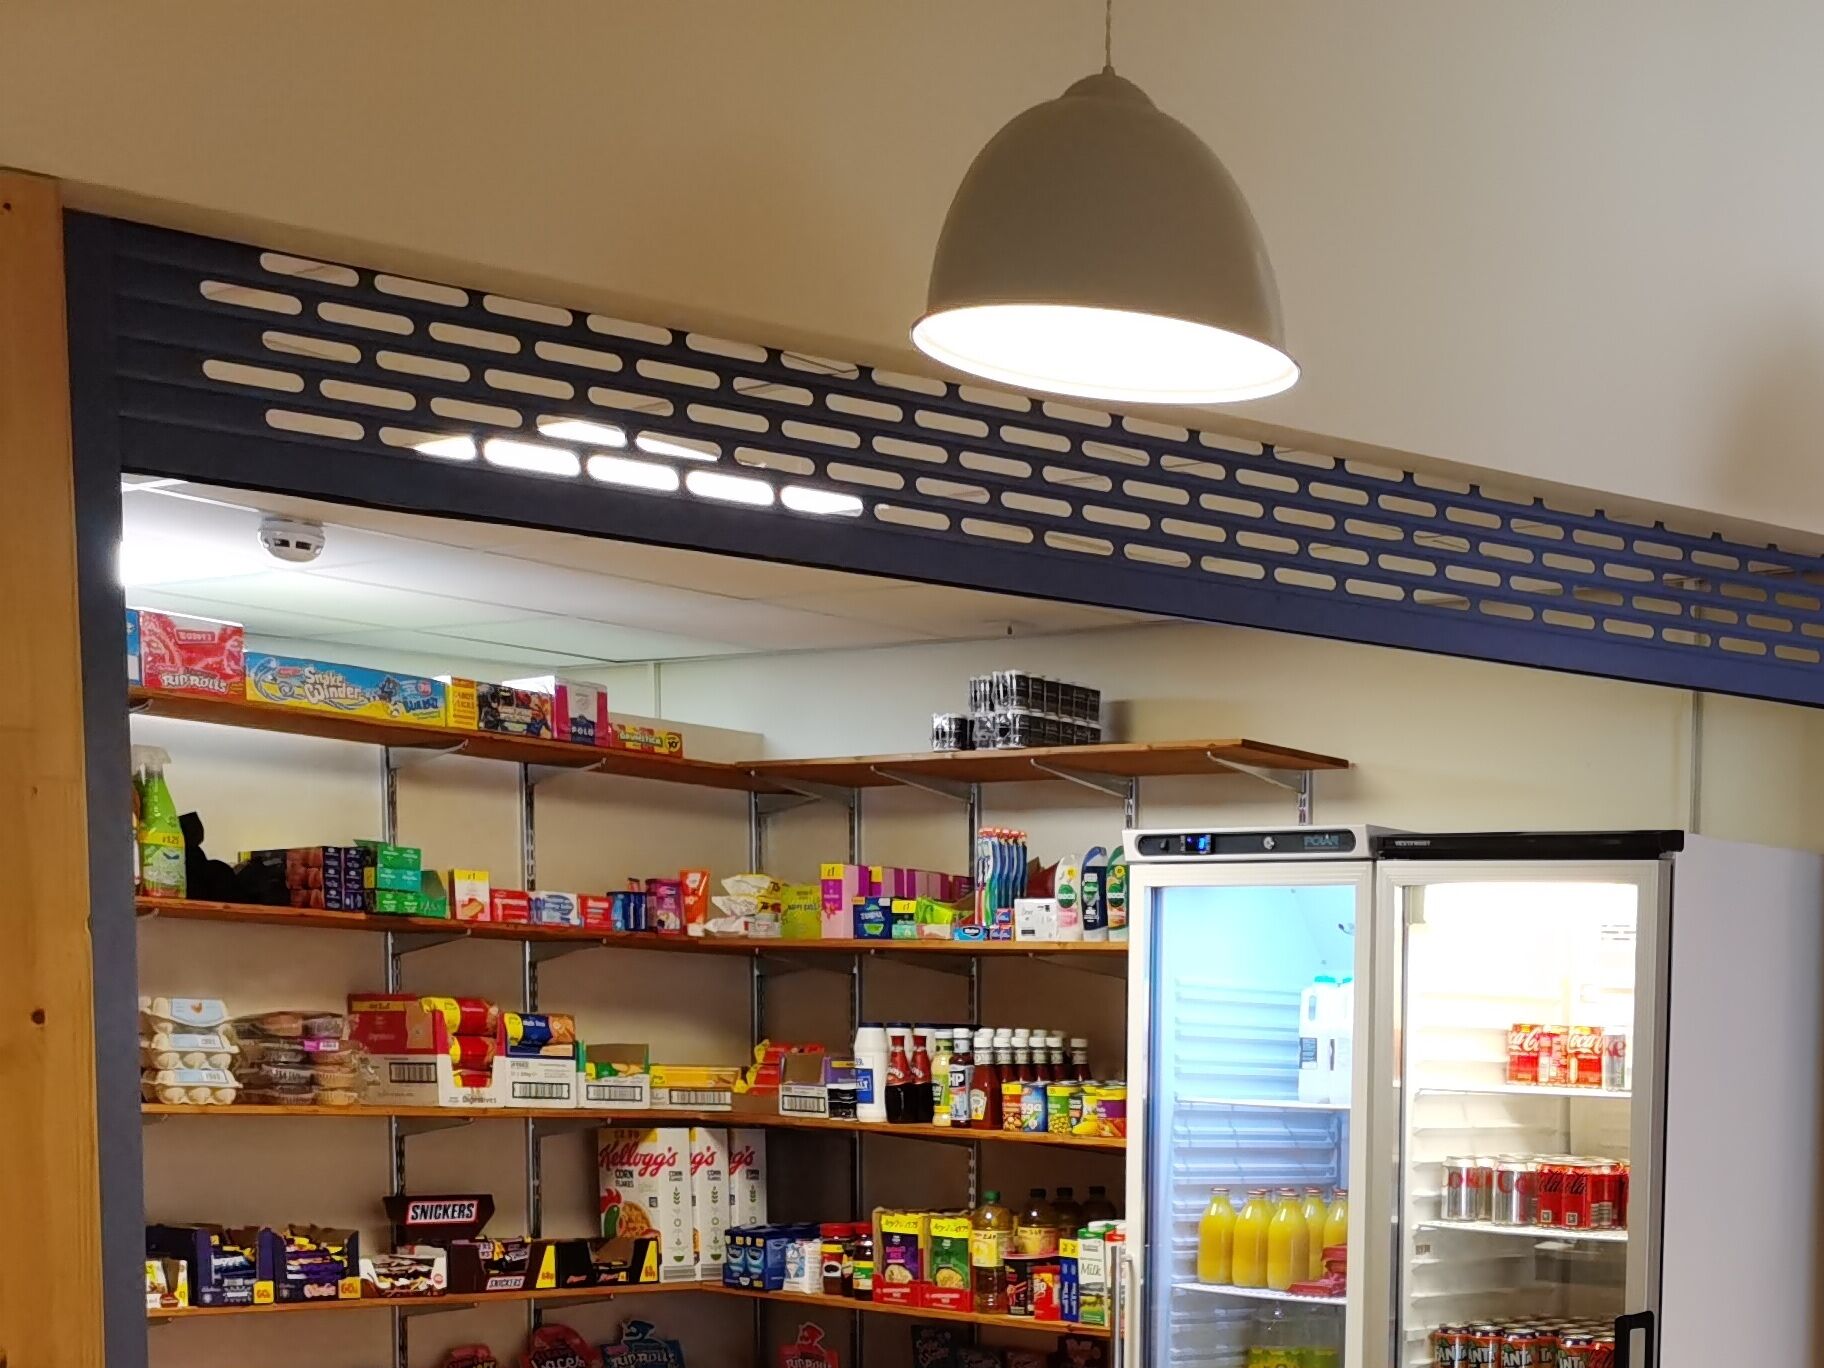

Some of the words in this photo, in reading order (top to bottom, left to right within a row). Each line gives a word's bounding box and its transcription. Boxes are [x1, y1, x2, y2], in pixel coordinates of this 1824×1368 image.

[163, 674, 188, 687] RIP
[190, 675, 227, 693] ROLLS
[304, 667, 345, 687] Snake
[571, 726, 594, 736] POLO
[1304, 835, 1339, 847] POLAR
[600, 1139, 678, 1177] Kellogg's
[615, 1169, 634, 1179] CORN
[411, 1202, 475, 1221] SNICKERS
[1080, 1263, 1101, 1276] Milk
[489, 1277, 523, 1288] SNICKERS
